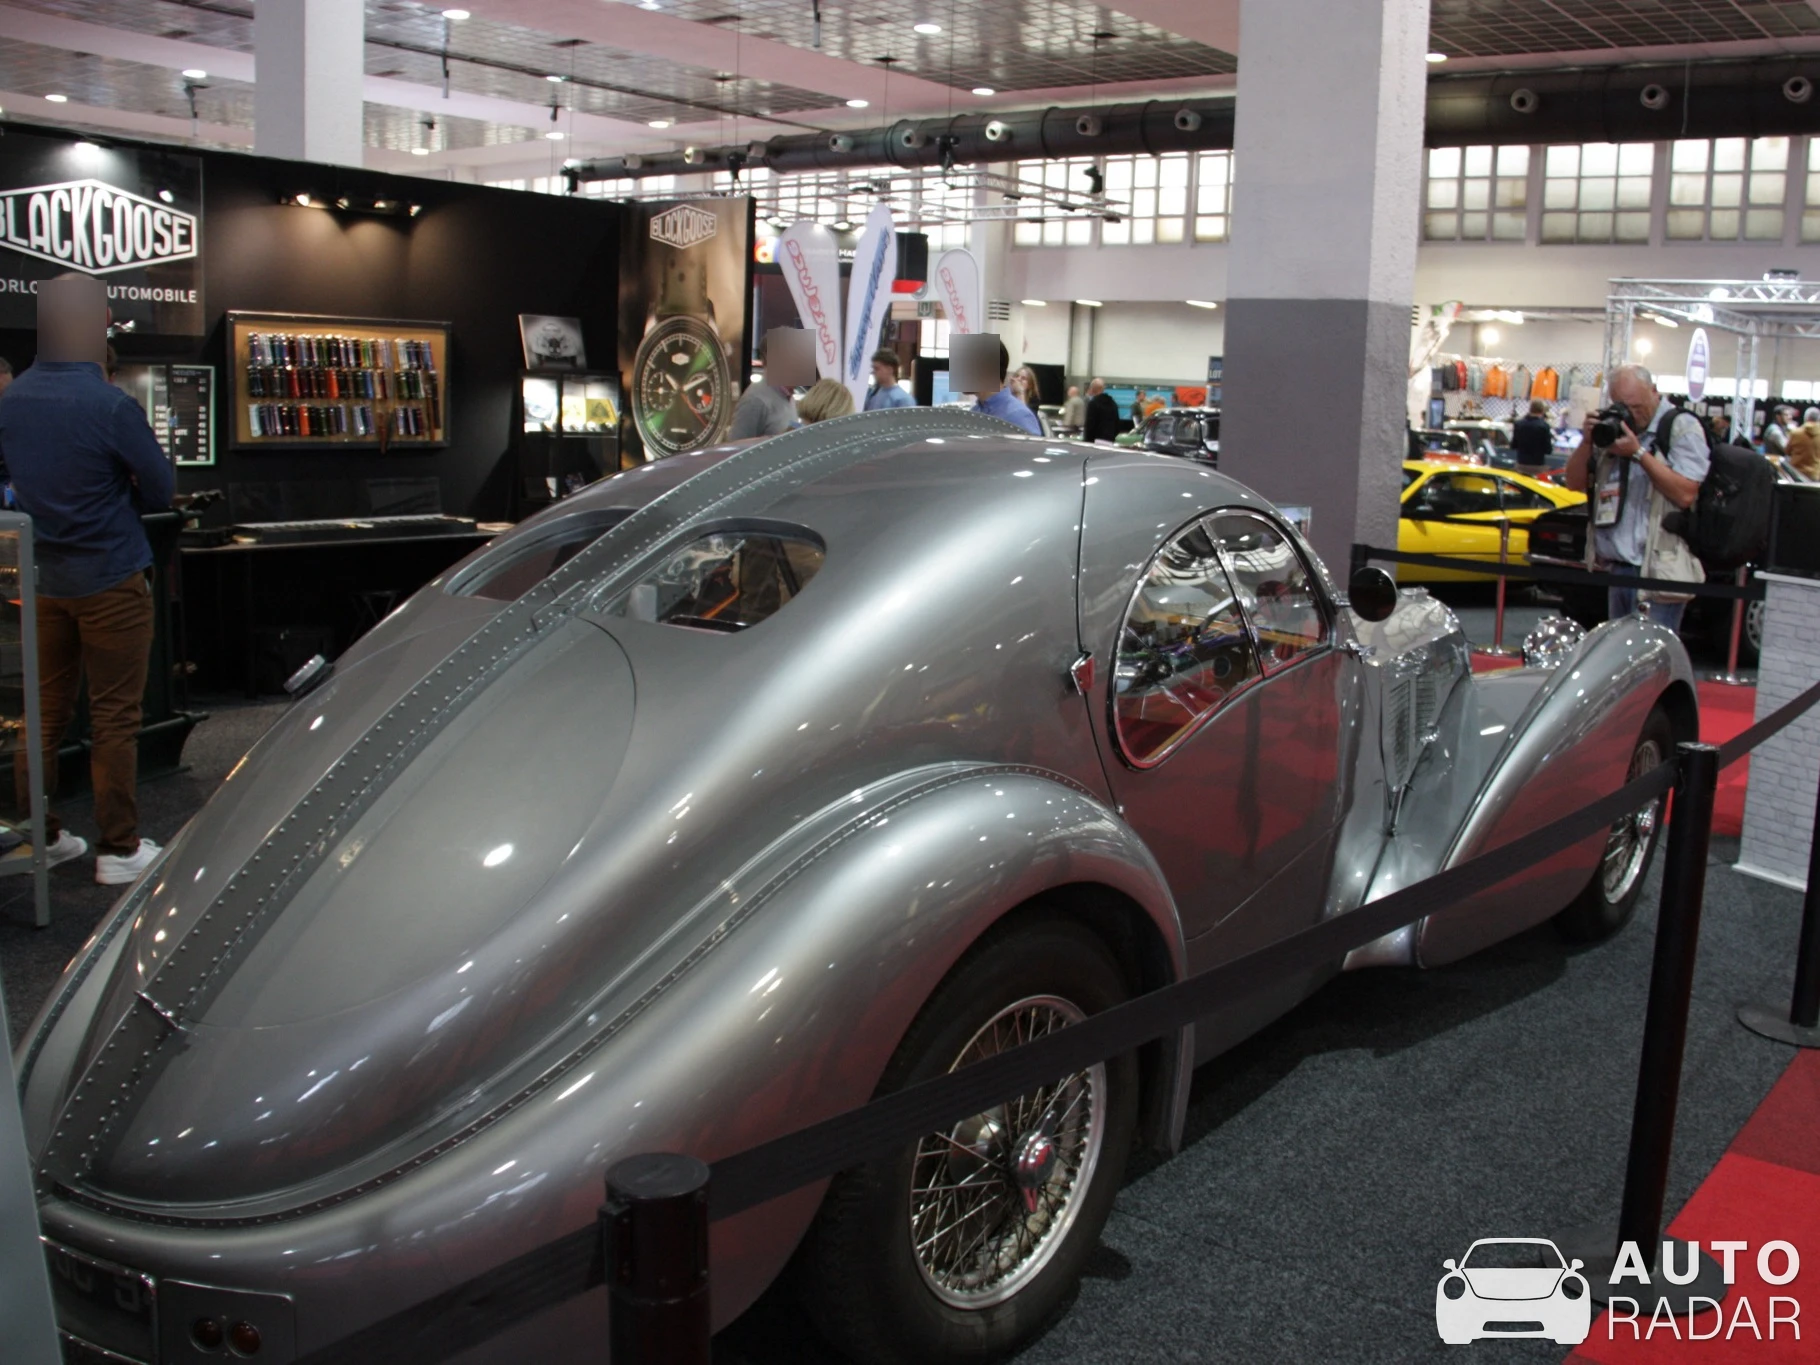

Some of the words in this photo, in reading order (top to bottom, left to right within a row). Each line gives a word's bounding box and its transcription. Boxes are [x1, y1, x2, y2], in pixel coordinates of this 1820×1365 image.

[0, 186, 191, 268] LACKGOOSE
[652, 209, 715, 246] BLACKGOOSE
[107, 286, 197, 303] UTOMOBILE
